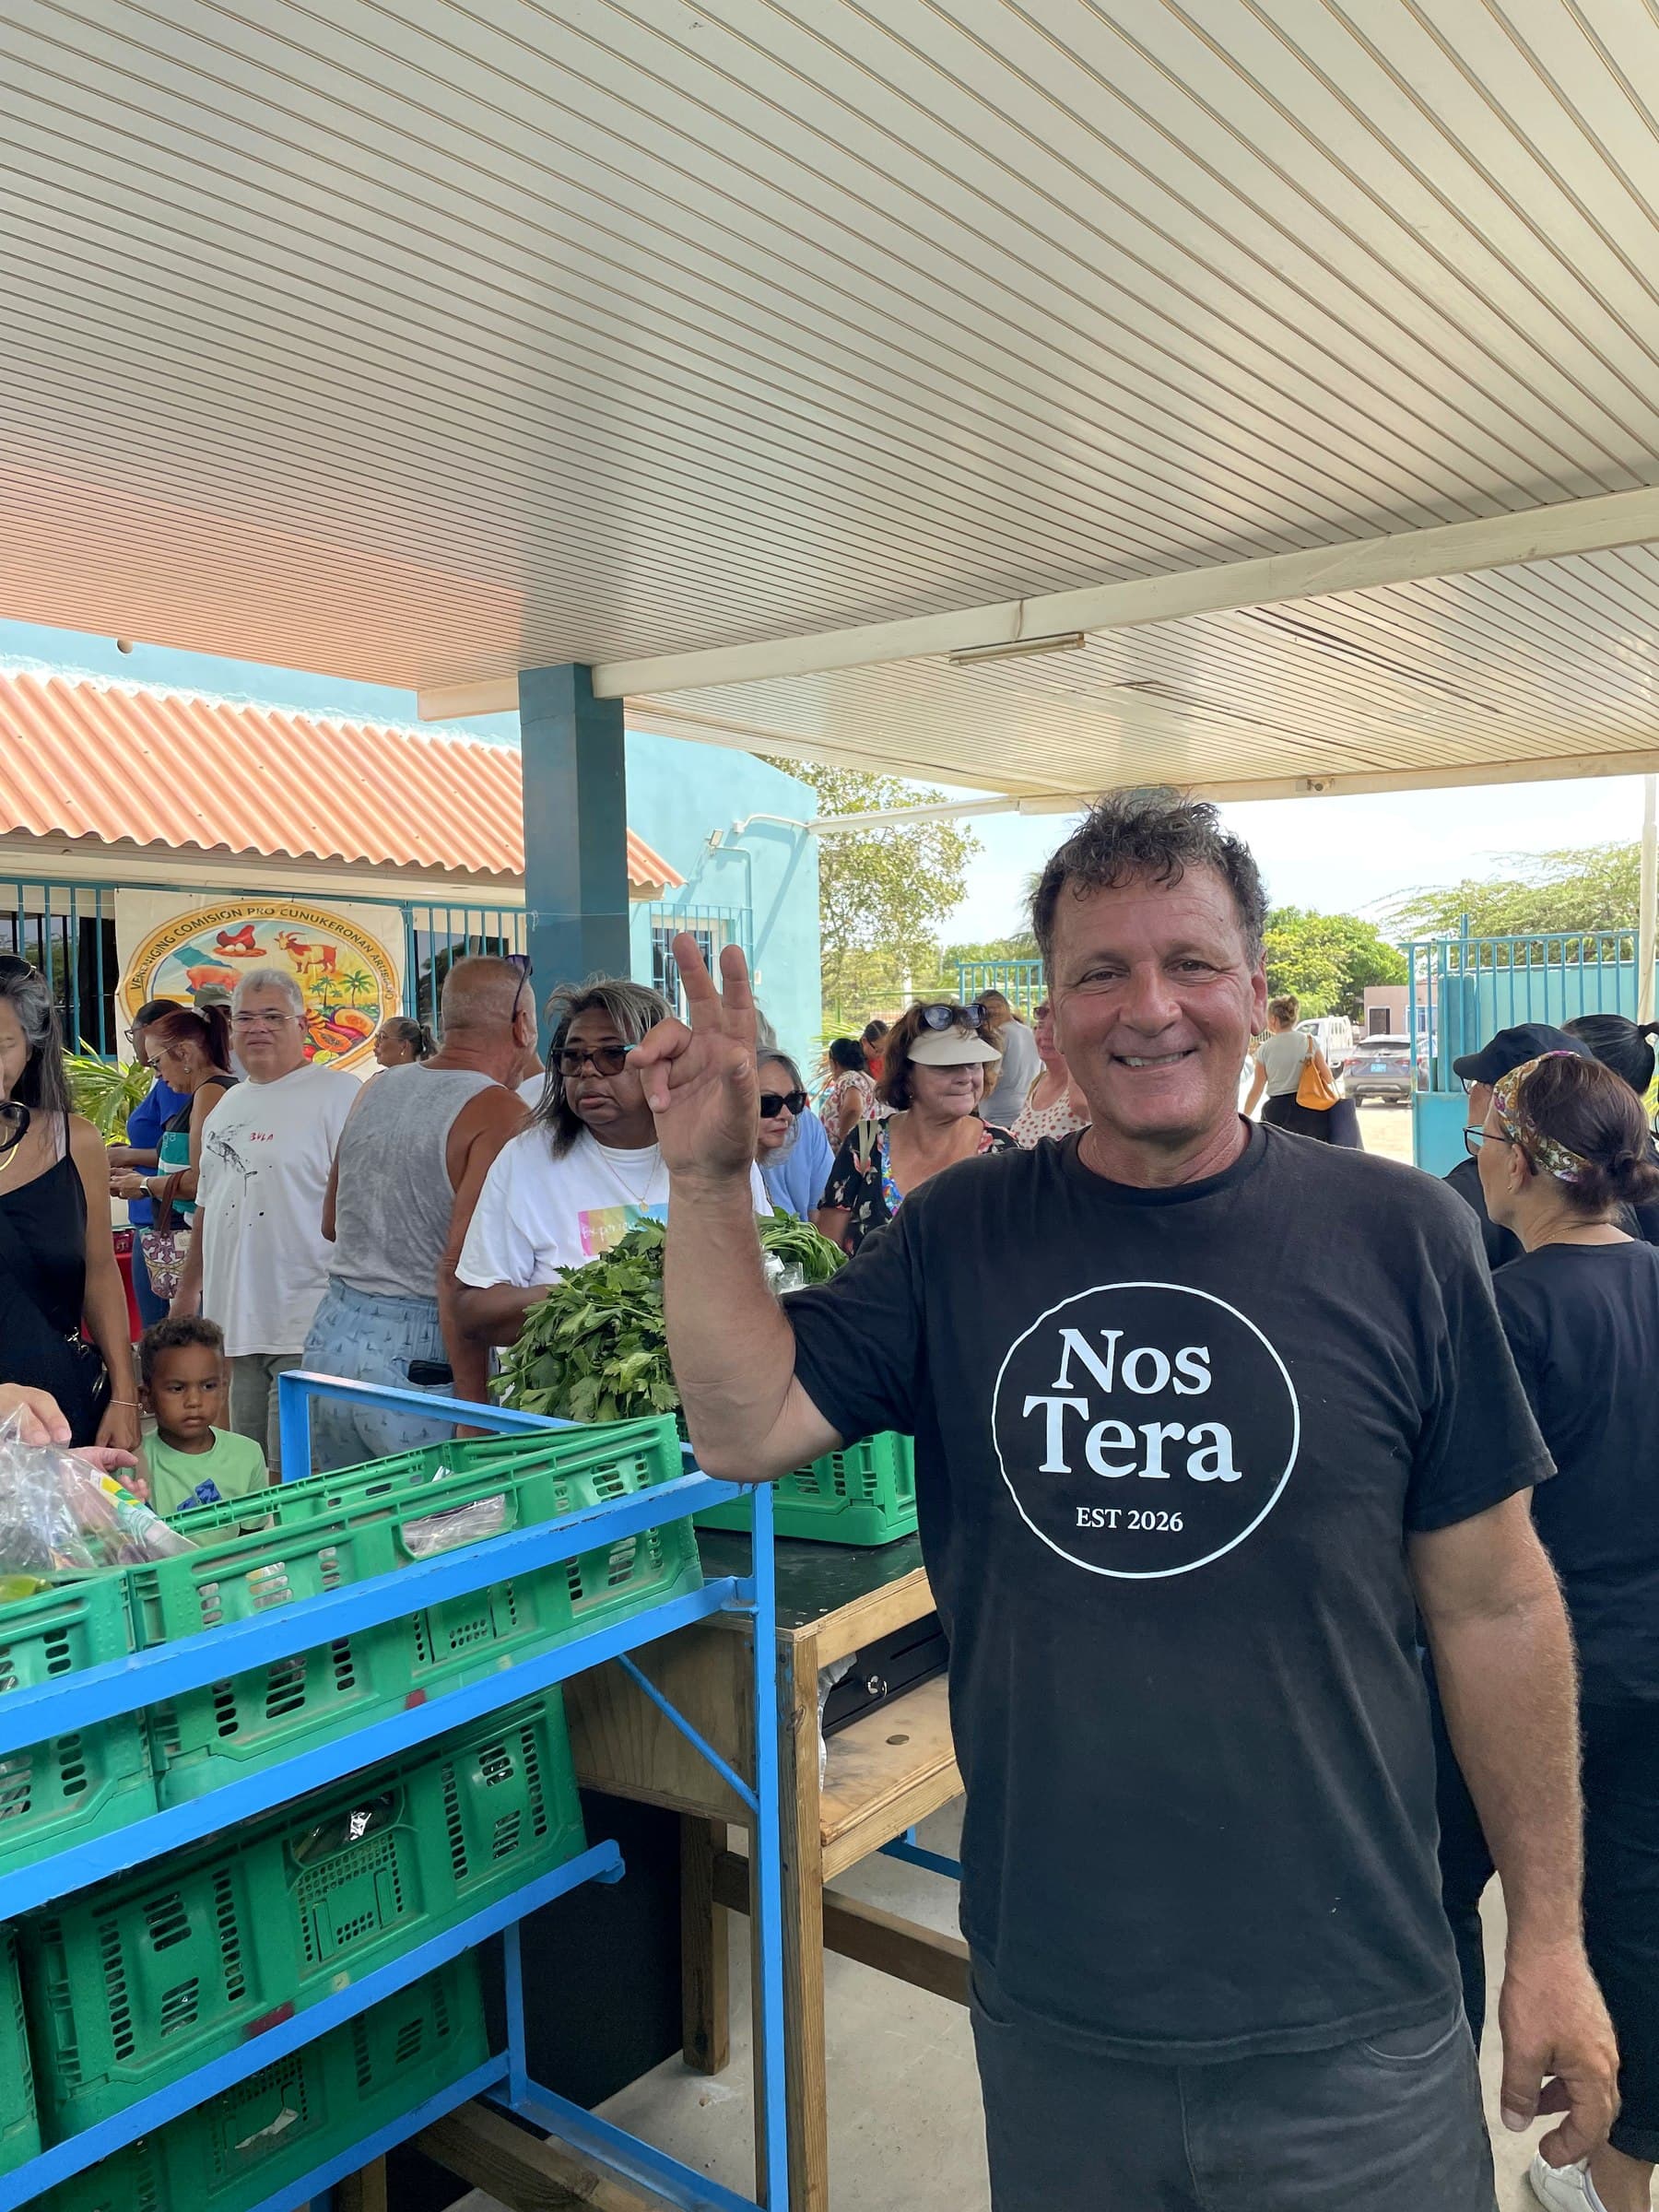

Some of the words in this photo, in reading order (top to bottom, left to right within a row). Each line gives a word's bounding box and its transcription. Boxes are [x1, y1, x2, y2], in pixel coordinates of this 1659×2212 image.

[130, 935, 176, 990] VERENIGING
[173, 908, 242, 936] COMISION
[247, 907, 275, 915] PRO
[279, 908, 373, 953] CUNUKERONAN
[1052, 1328, 1212, 1394] Nos
[1022, 1395, 1242, 1482] Tera
[1076, 1506, 1122, 1528] EST
[1127, 1510, 1183, 1532] 2026
